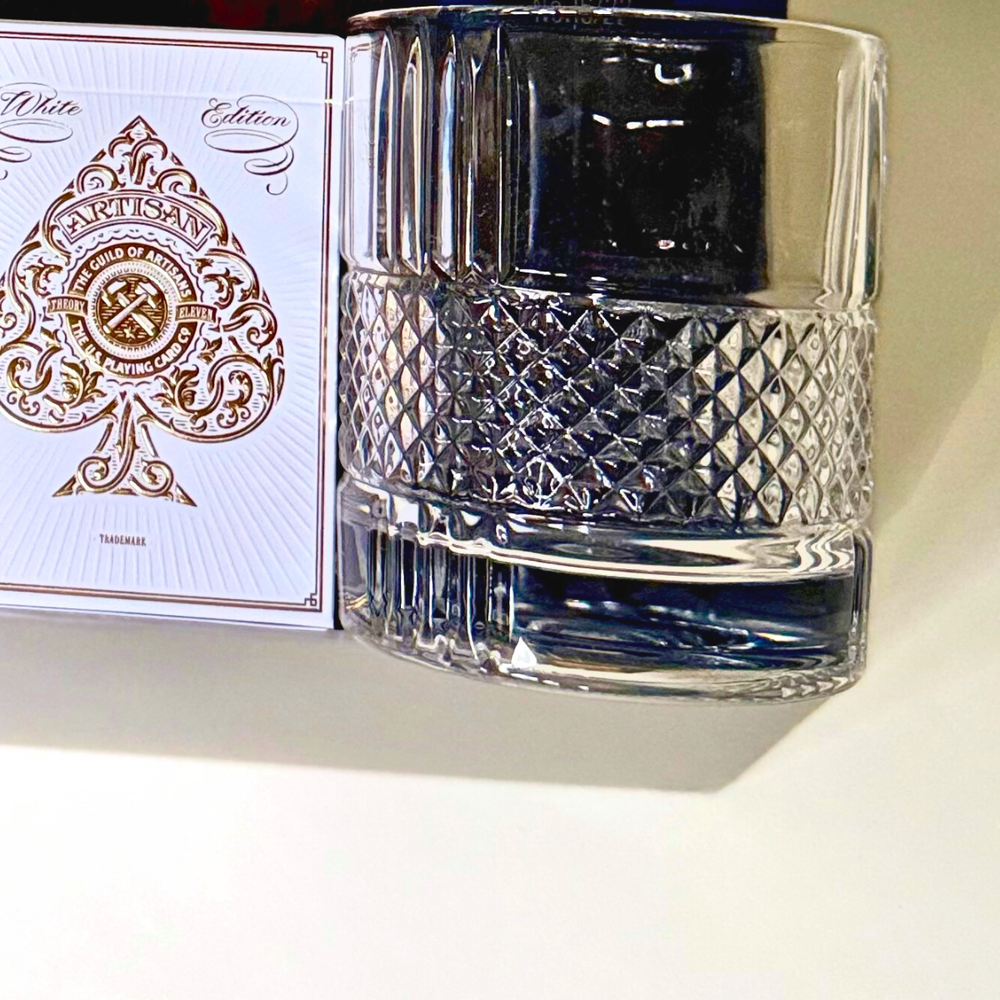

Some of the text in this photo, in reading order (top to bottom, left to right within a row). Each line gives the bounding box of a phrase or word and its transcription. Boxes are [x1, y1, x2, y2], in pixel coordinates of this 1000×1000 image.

[0, 89, 292, 128] White Edition
[66, 197, 209, 239] ARTISAN
[73, 246, 192, 298] THE GUILD OF ARTISANS
[50, 299, 214, 321] THEORY ELEVEN
[71, 320, 89, 348] THE
[103, 358, 154, 375] PLAYING
[154, 344, 182, 368] CARD
[99, 533, 147, 547] TRADEMARK
